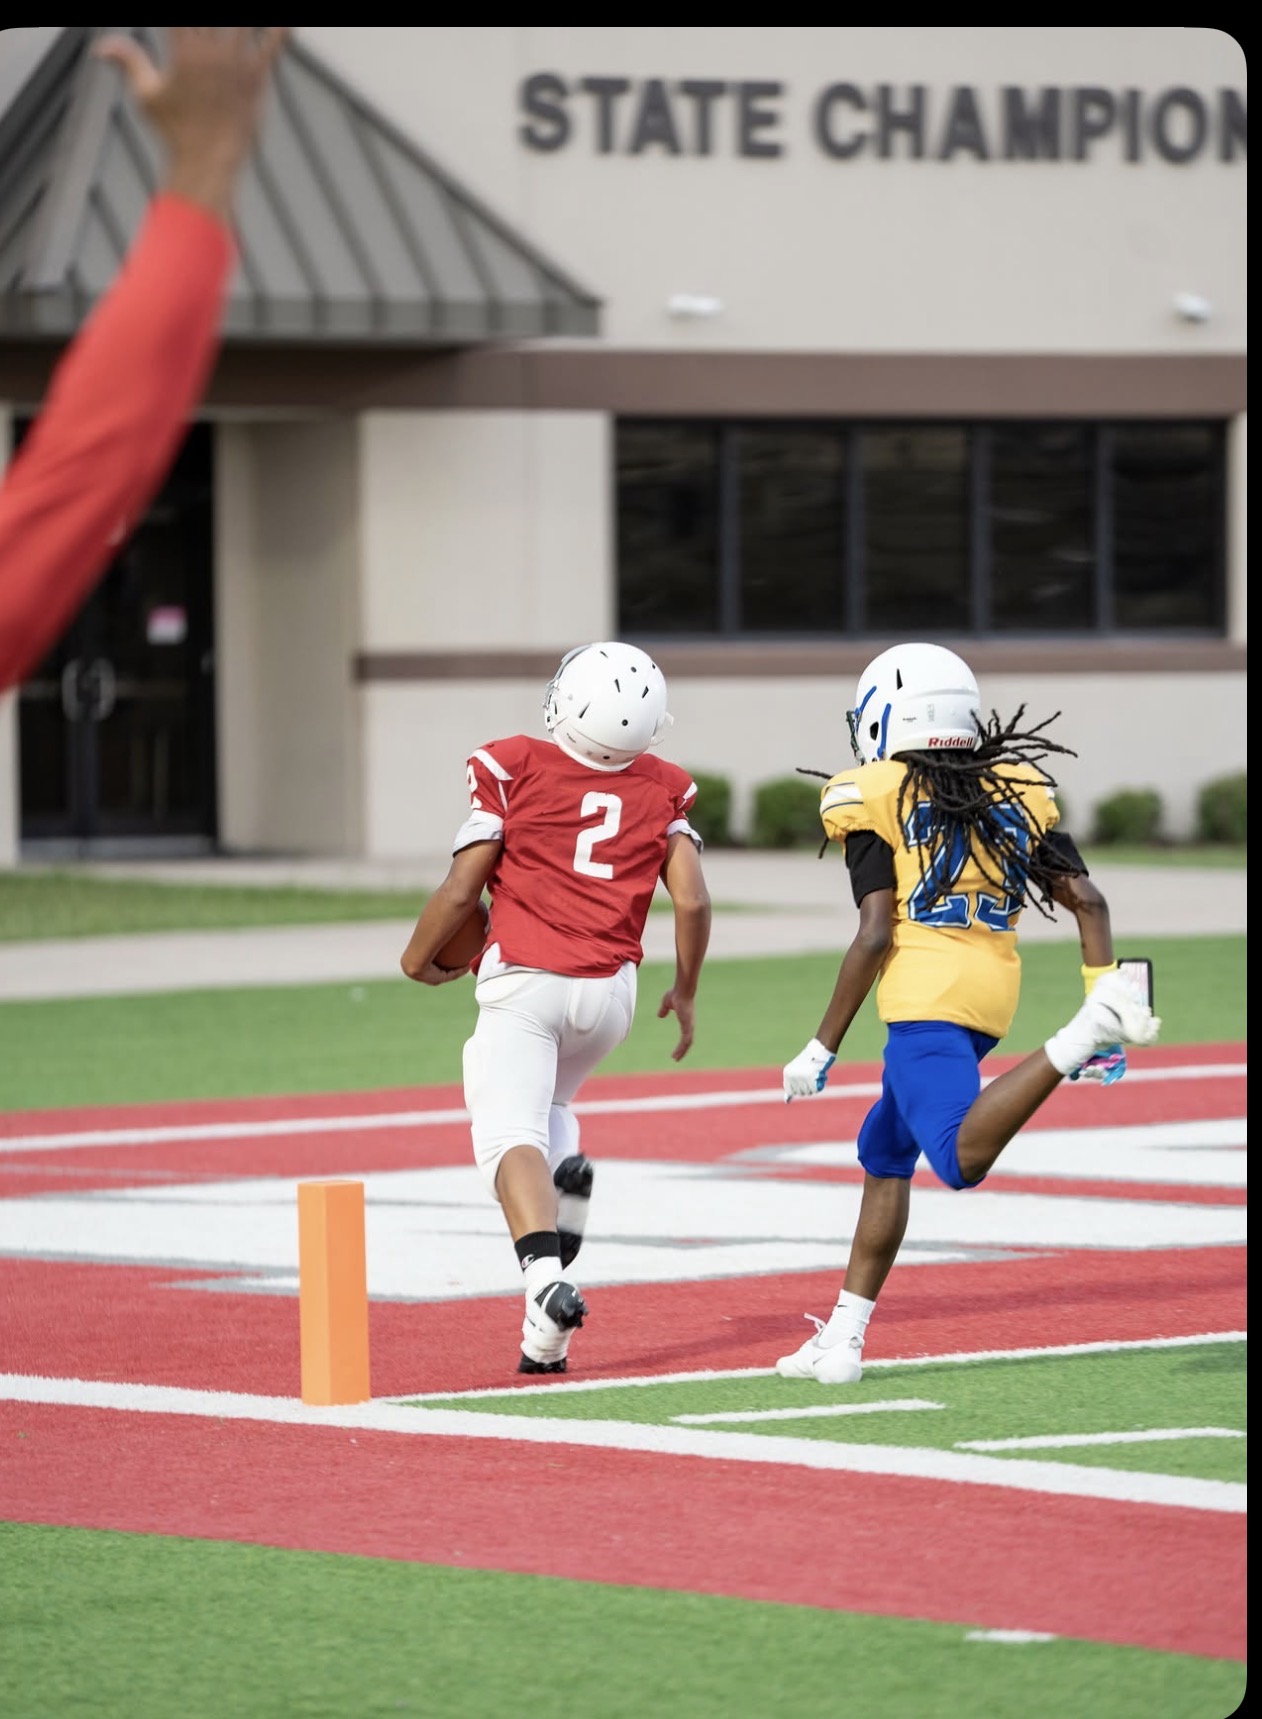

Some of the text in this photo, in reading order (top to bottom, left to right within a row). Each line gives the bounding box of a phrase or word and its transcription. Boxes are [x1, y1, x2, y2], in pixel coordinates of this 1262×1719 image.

[518, 73, 784, 160] STATE
[928, 736, 974, 748] Riddell
[572, 791, 623, 880] 2
